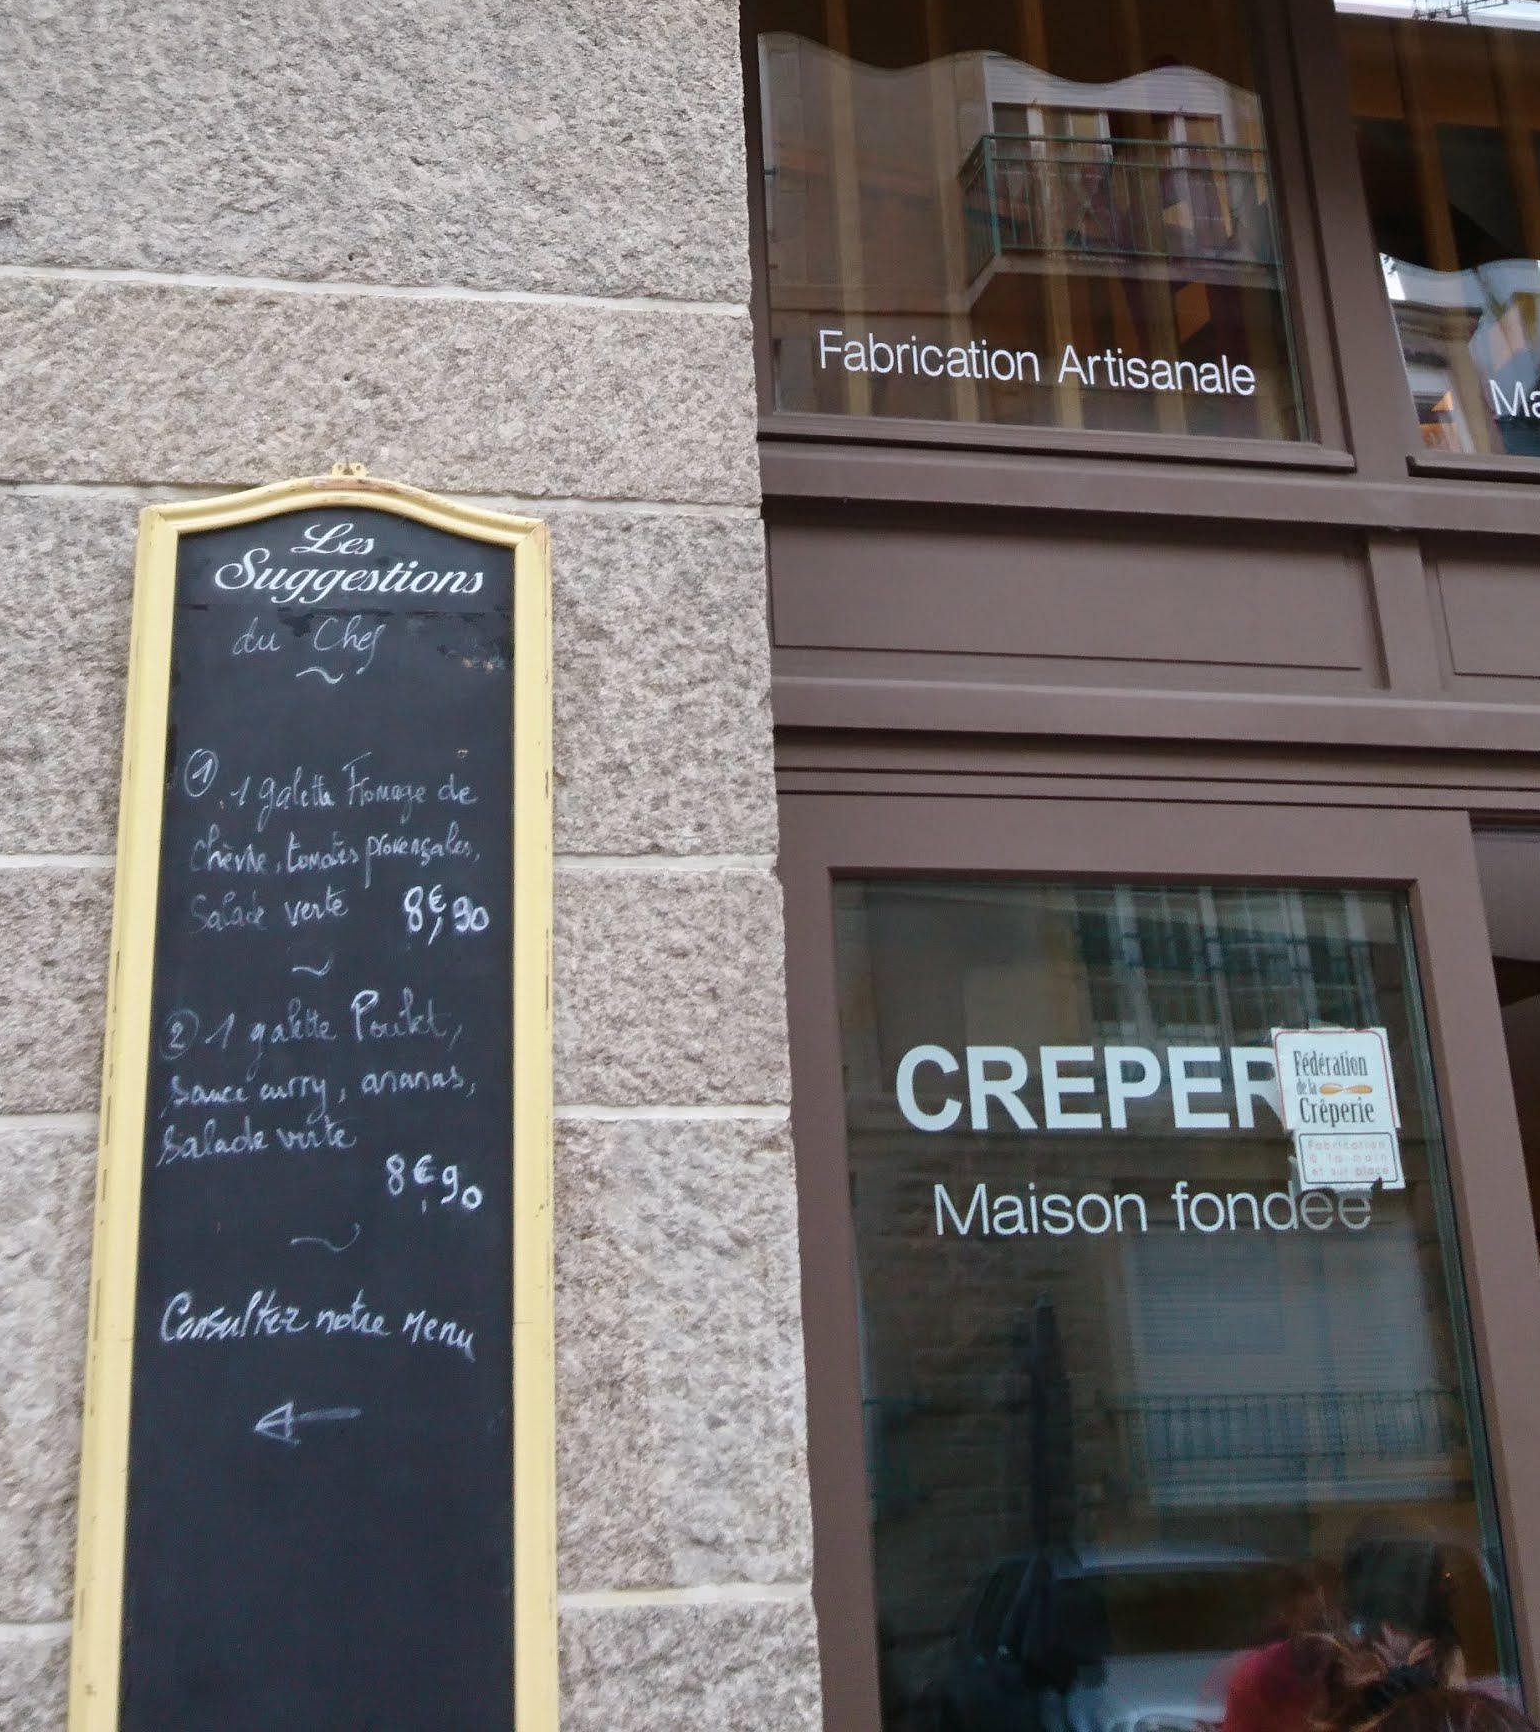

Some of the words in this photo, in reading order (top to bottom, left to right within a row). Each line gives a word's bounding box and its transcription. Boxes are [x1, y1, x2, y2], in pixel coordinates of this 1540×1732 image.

[817, 328, 1039, 383] Fabrication
[1057, 343, 1256, 397] Artisanale
[290, 522, 374, 556] Les
[214, 548, 485, 604] Suggestions
[232, 615, 281, 656] du
[312, 614, 387, 675] Chef
[438, 773, 479, 805] de
[284, 883, 349, 927] verte
[895, 1044, 1285, 1132] CREPER
[1293, 1050, 1368, 1077] Fédération
[276, 1114, 357, 1150] verte
[1299, 1096, 1375, 1127] Crêperie
[933, 1181, 1148, 1236] Maison
[160, 1288, 311, 1345] Consultez
[316, 1288, 391, 1336] notre
